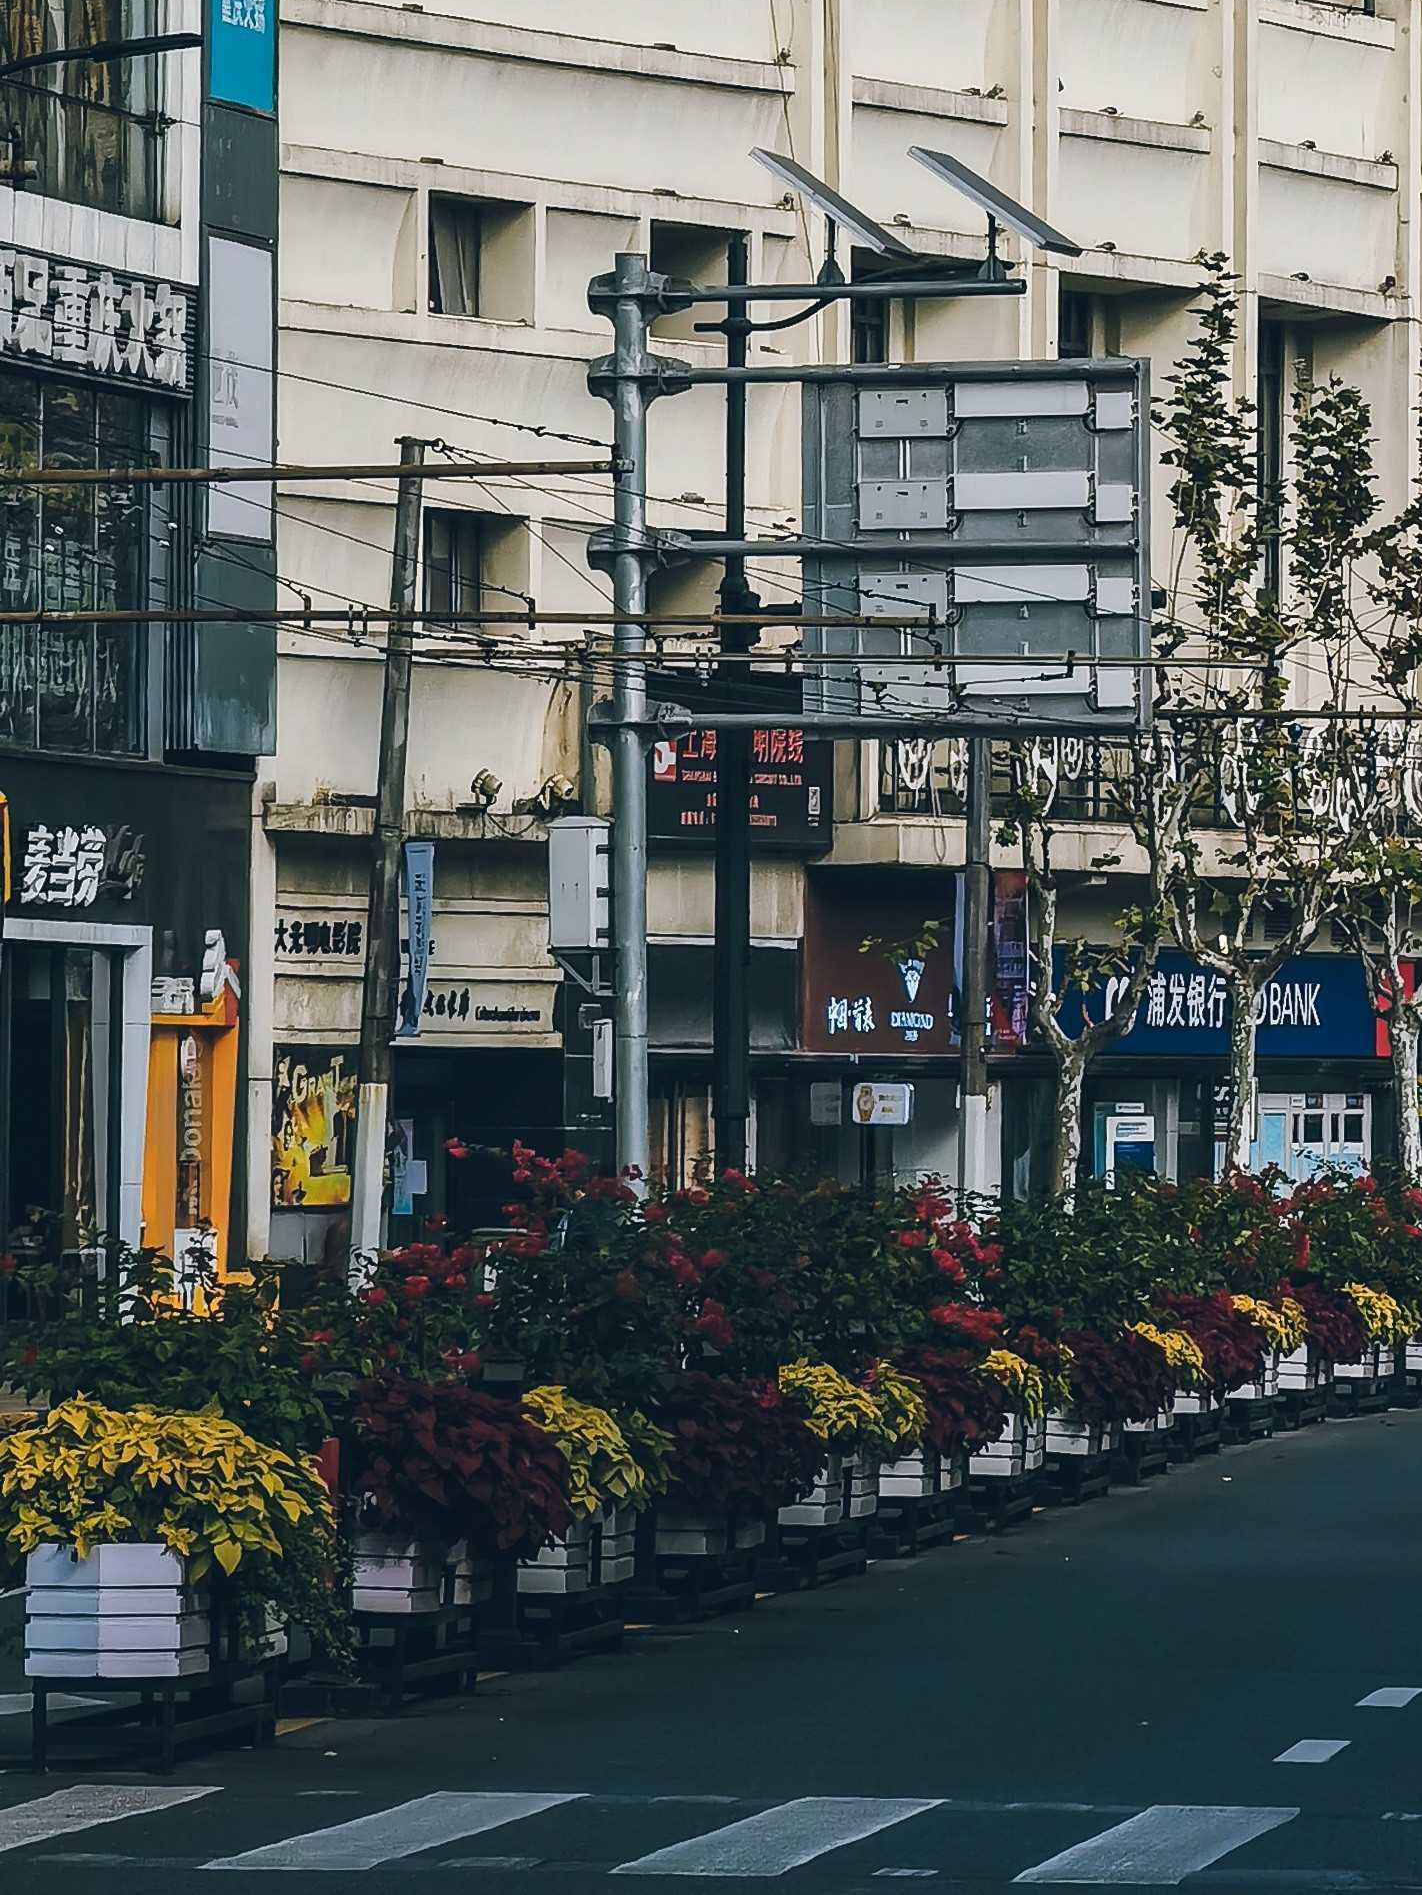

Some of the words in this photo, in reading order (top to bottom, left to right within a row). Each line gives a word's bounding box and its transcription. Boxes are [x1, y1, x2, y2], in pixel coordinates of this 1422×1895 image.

[682, 728, 804, 763] 上海明院线
[20, 824, 107, 906] 麦当劳
[1147, 971, 1226, 1028] 浦发银行
[1270, 982, 1321, 1026] BANK
